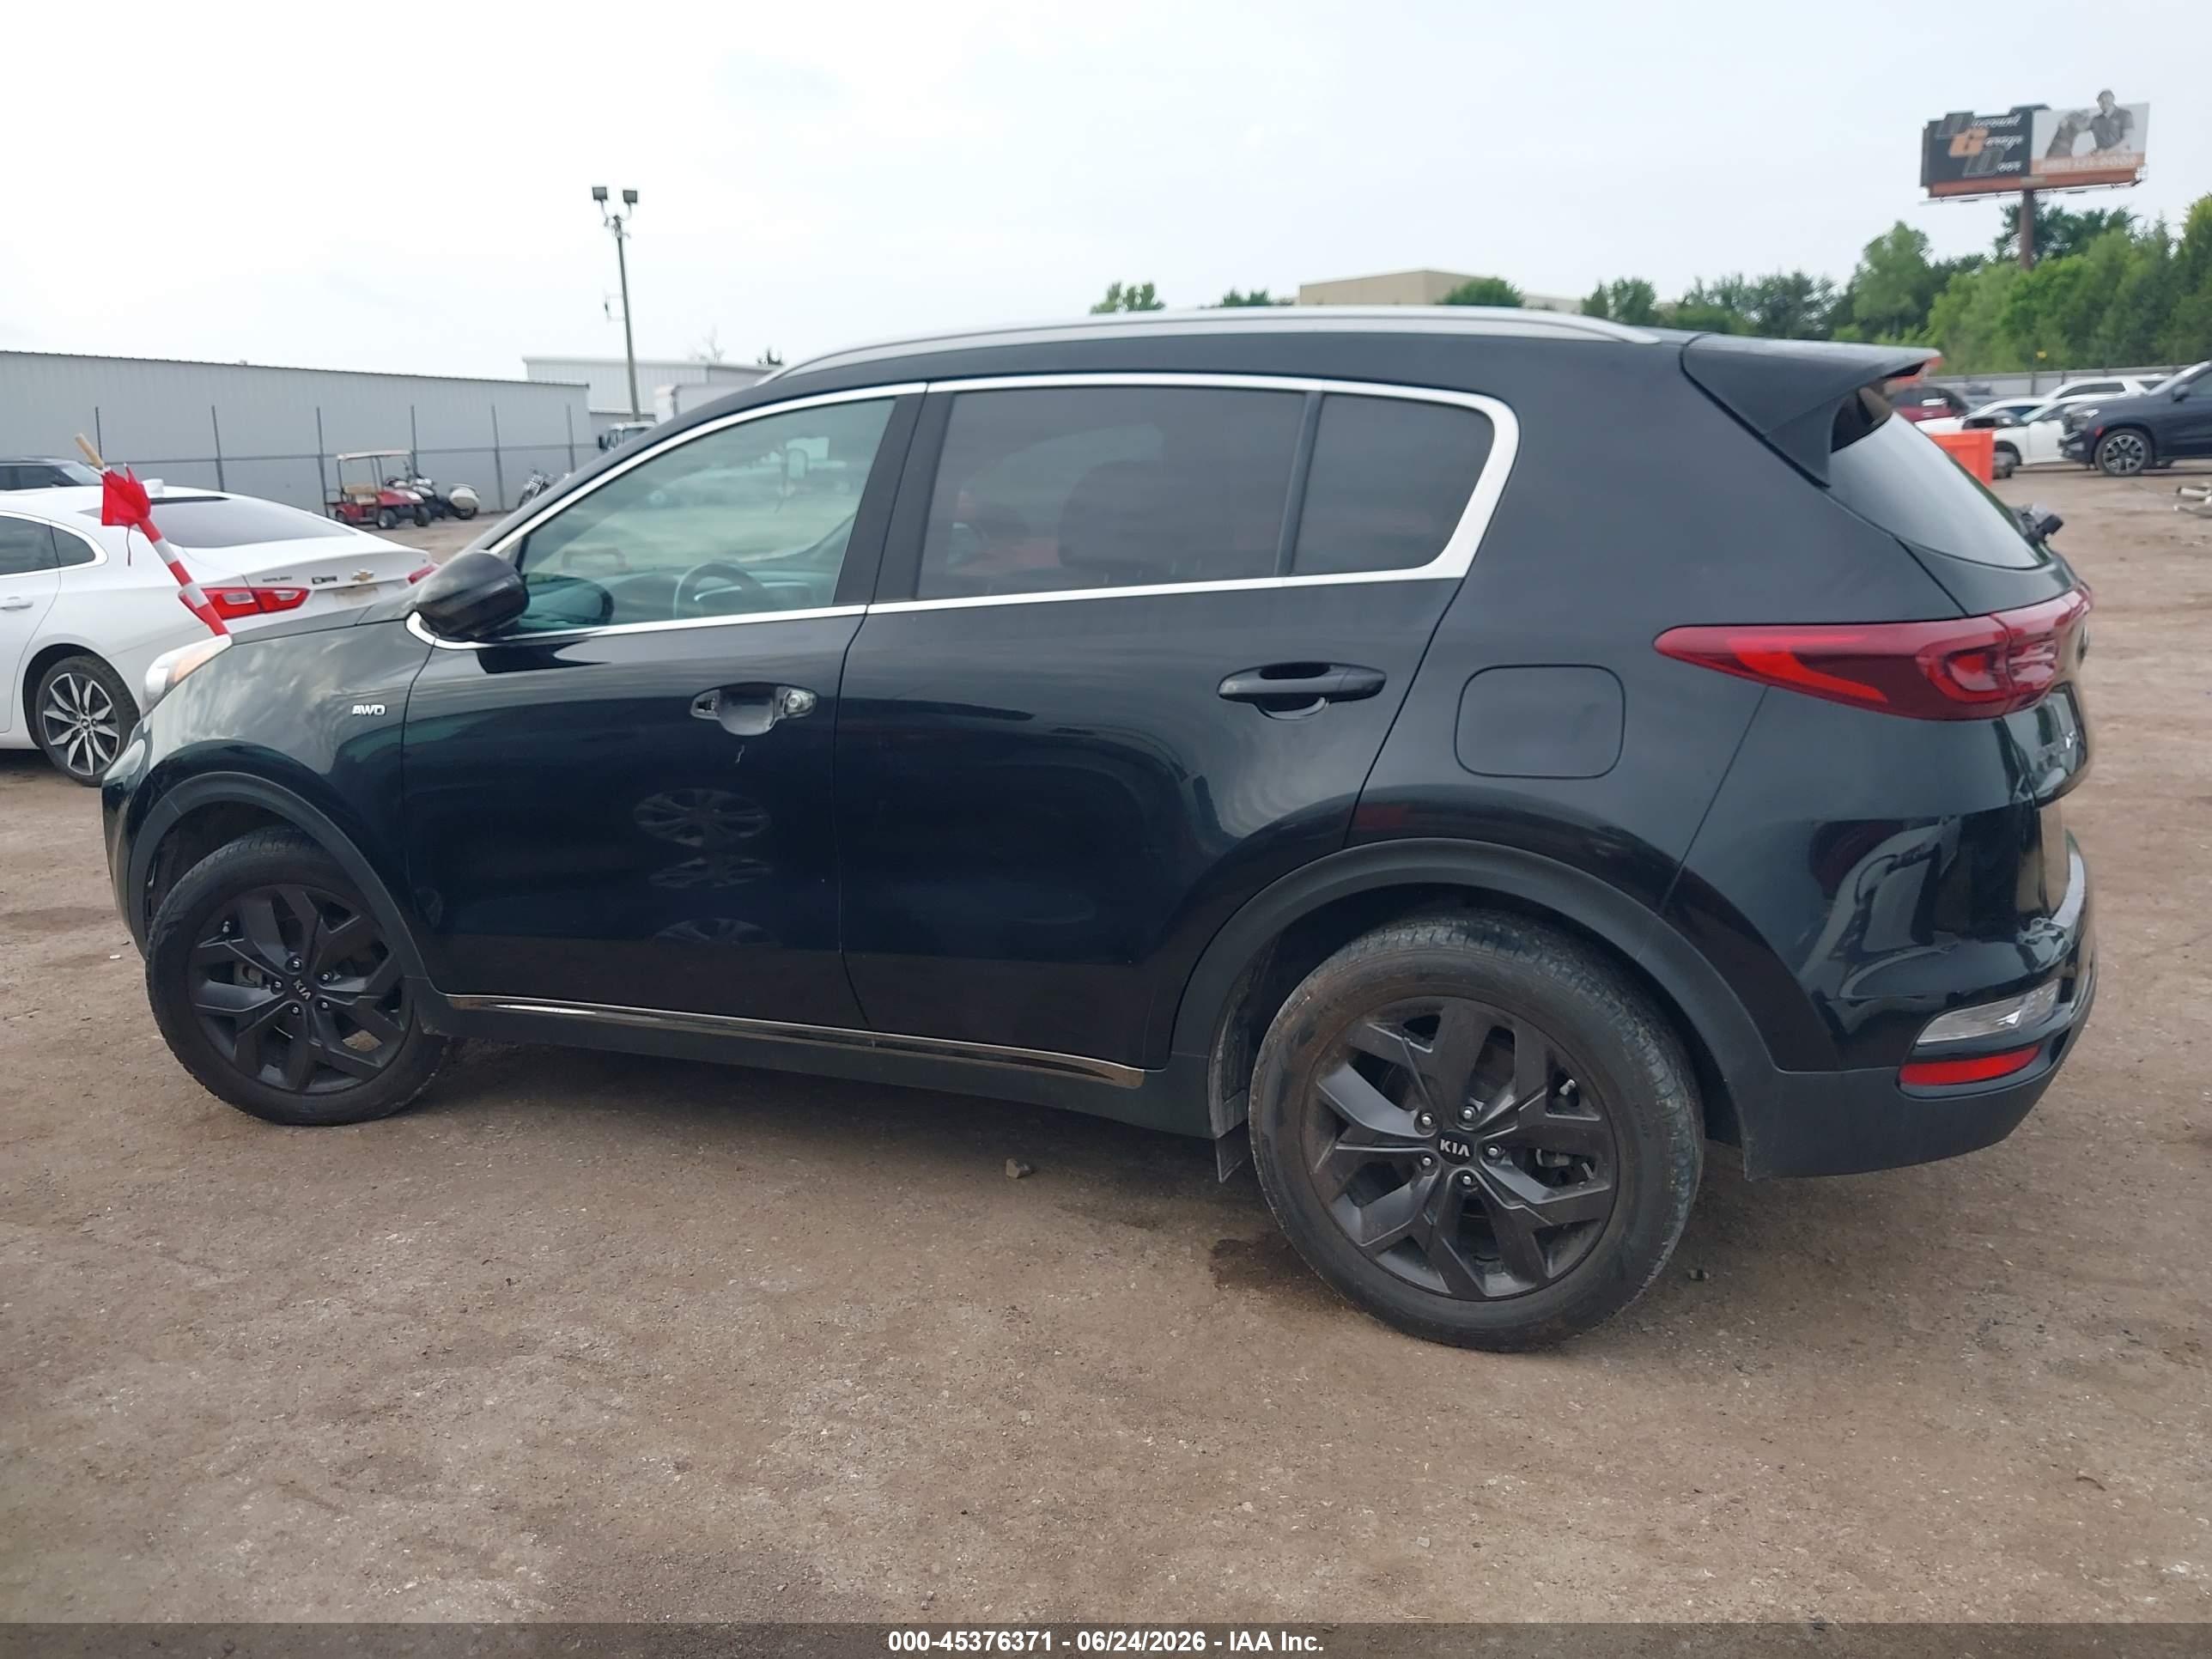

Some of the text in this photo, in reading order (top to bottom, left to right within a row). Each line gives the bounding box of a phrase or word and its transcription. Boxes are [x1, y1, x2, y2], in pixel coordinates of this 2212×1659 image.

[352, 704, 386, 715] AWD
[293, 979, 312, 1000] KIA
[1439, 1139, 1470, 1158] KIA
